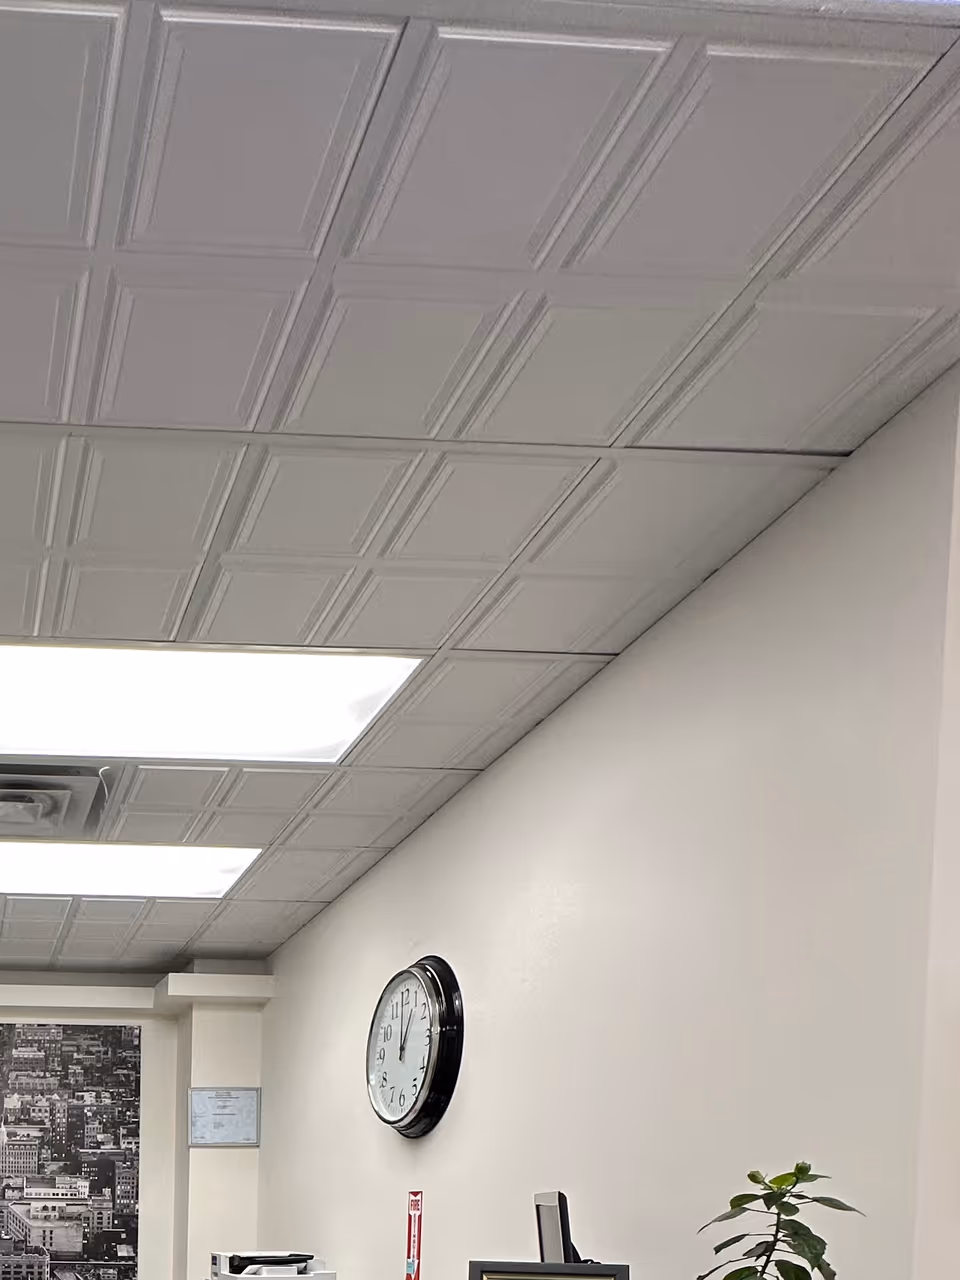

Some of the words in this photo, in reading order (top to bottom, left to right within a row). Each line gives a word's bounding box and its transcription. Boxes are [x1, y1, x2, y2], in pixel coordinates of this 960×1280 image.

[391, 1001, 399, 1020] 11
[420, 1003, 427, 1020] 2
[383, 1024, 393, 1042] 10
[424, 1028, 431, 1047] 3
[379, 1047, 386, 1064] 9
[380, 1071, 388, 1088] 8
[411, 1077, 418, 1096] 5
[389, 1086, 396, 1104] 7
[398, 1088, 406, 1107] 6
